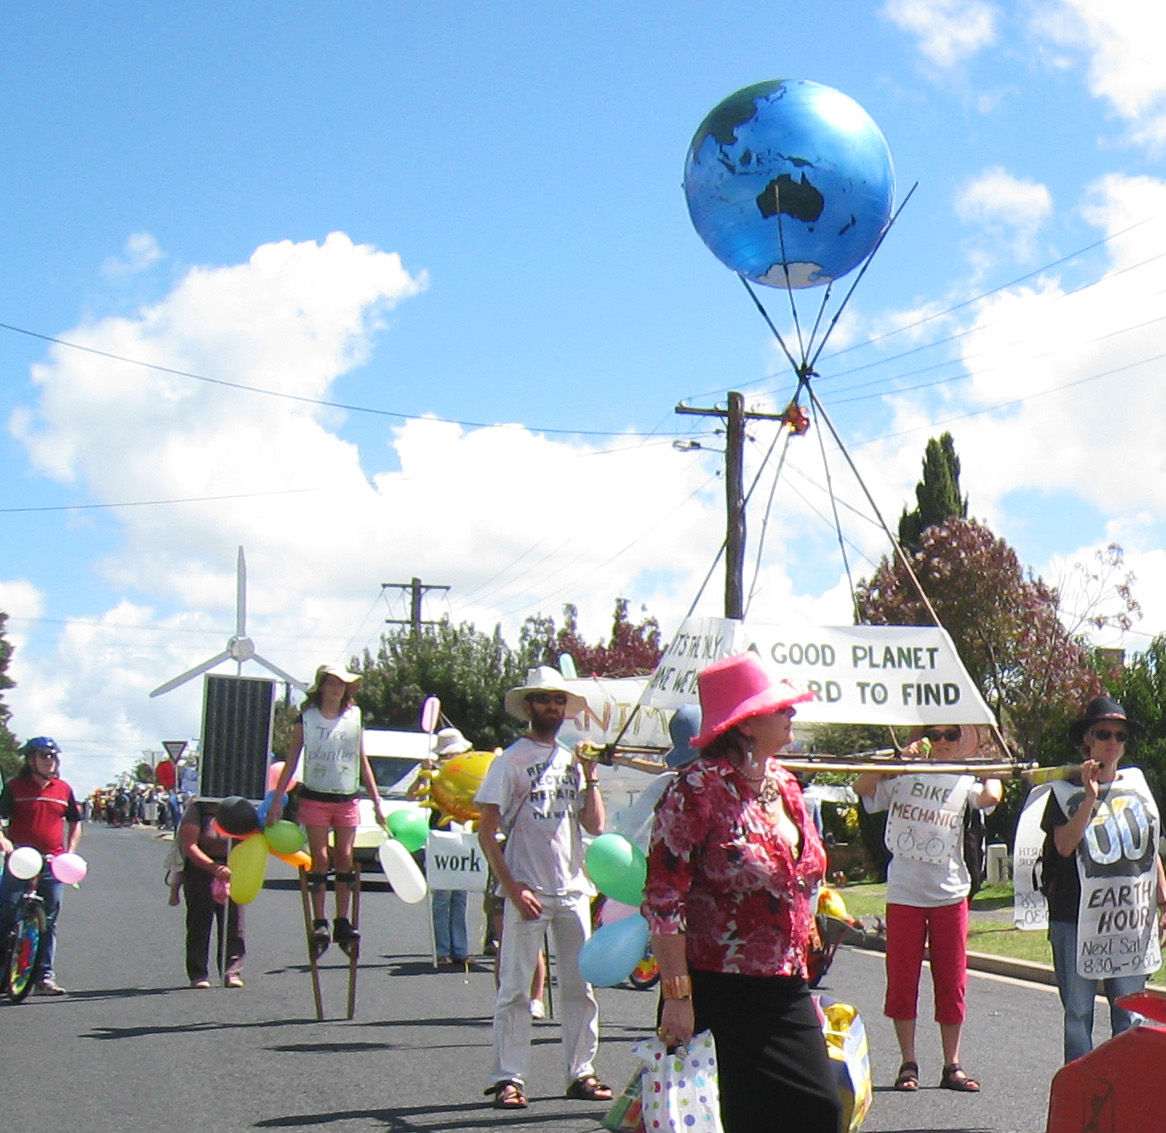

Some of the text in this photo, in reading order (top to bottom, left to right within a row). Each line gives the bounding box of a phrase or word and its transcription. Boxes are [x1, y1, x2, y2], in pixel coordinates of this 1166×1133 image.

[770, 641, 836, 668] GOOD
[851, 644, 940, 670] PLANET
[807, 679, 962, 708] RD TO FIND
[315, 726, 347, 741] Tree
[308, 747, 354, 765] planter
[910, 781, 951, 804] BIKE
[890, 801, 961, 829] MECHANIC
[433, 847, 481, 873] work
[1087, 880, 1153, 910] EARTH
[1097, 905, 1151, 935] HOUR
[1081, 938, 1113, 957] Next
